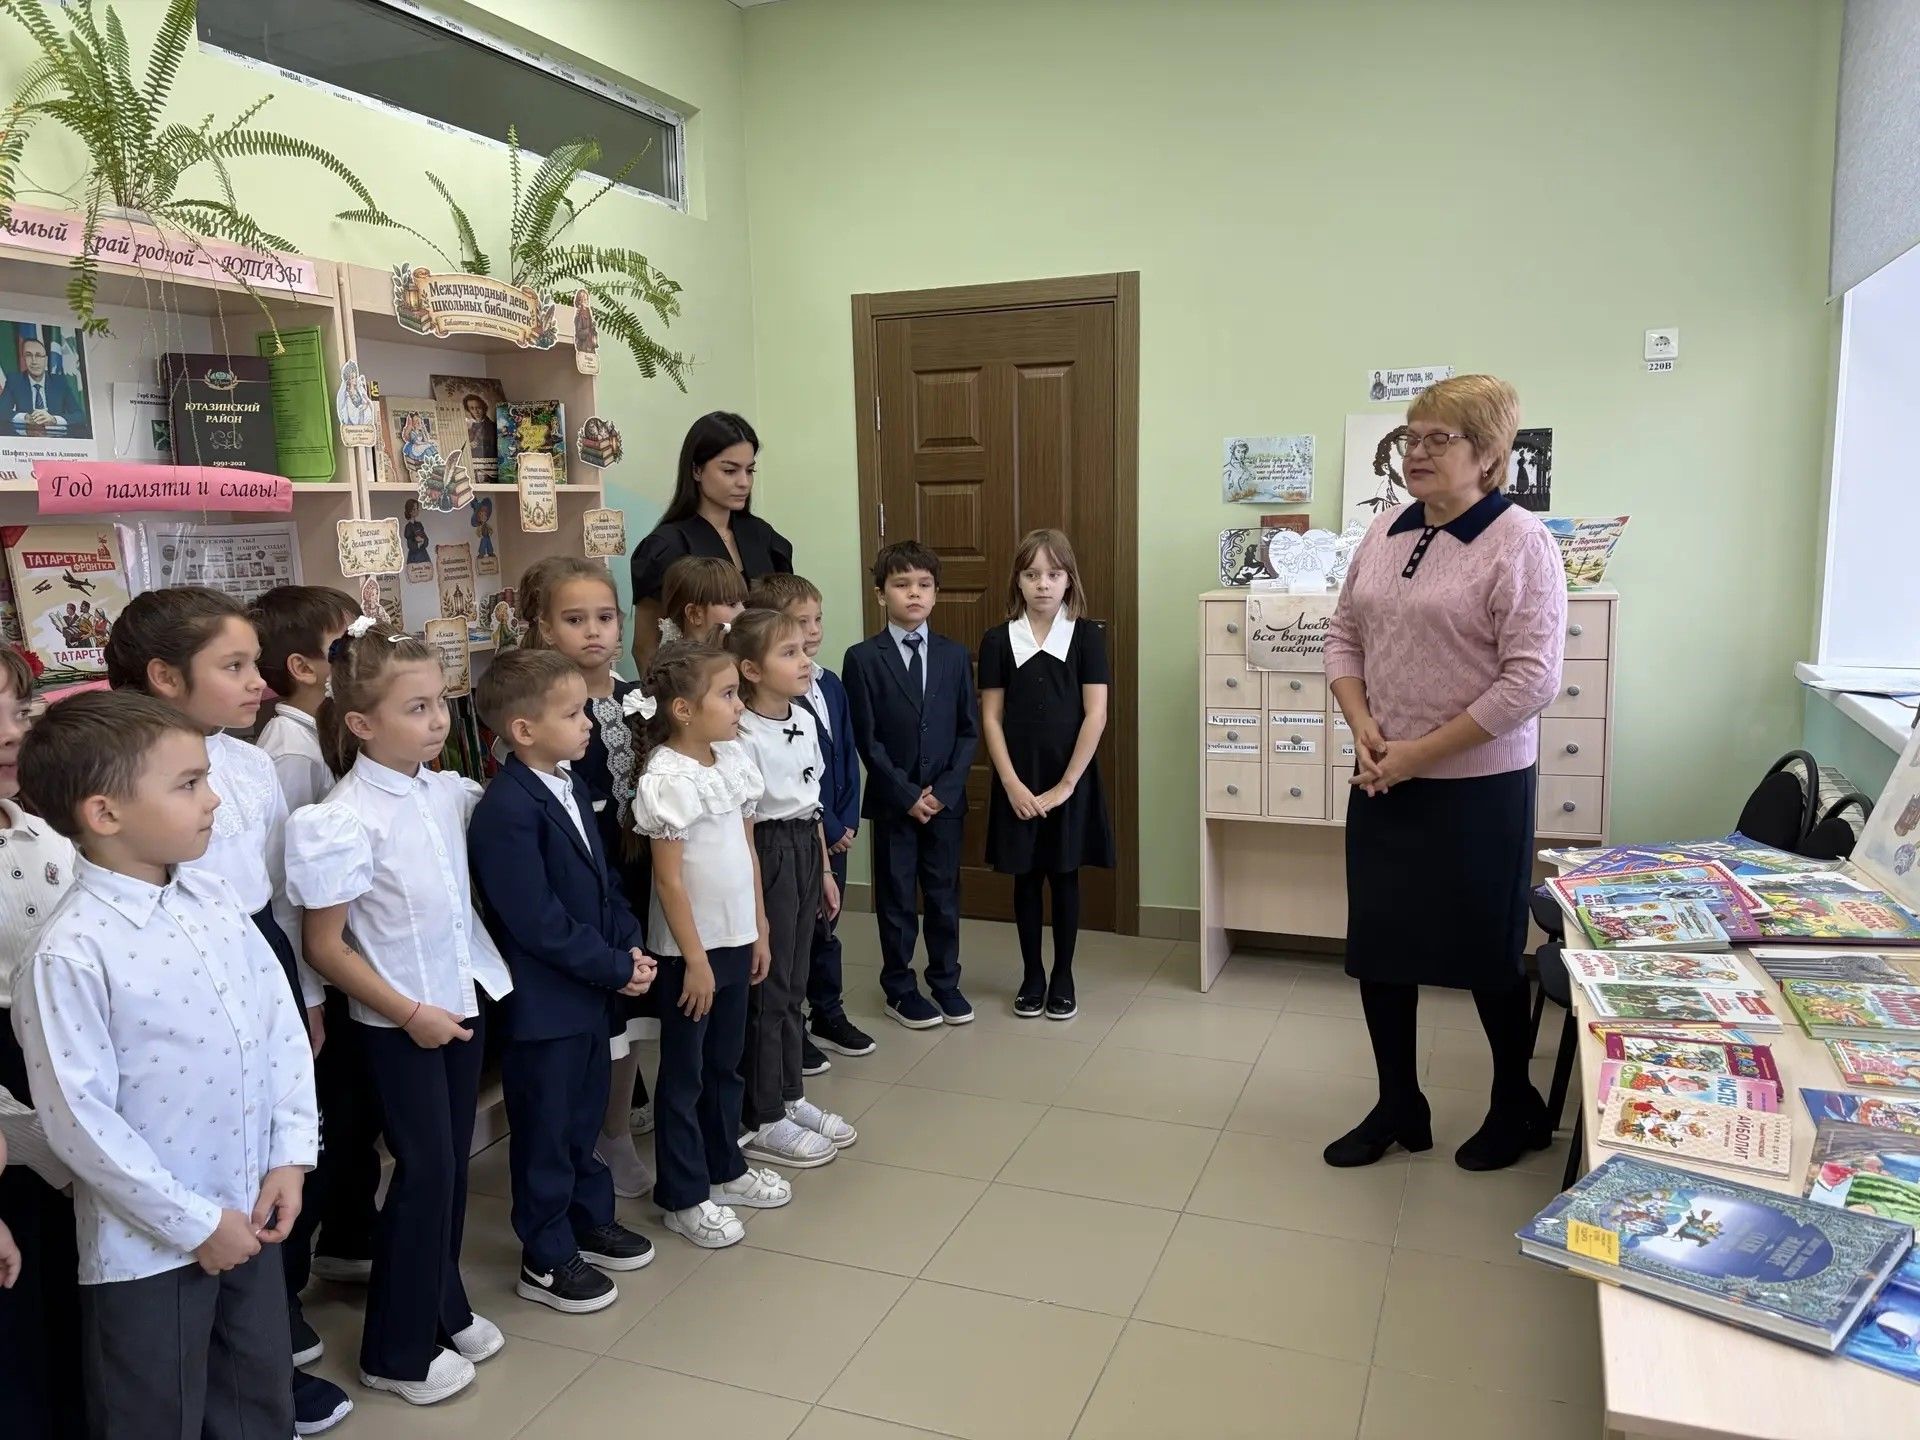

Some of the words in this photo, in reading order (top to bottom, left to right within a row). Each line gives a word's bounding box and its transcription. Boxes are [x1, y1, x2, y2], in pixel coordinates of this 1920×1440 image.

[132, 238, 195, 267] родной
[221, 255, 304, 284] ЮТАЗЫ
[428, 282, 508, 303] Международный
[509, 297, 530, 311] день
[431, 299, 482, 314] школьных
[484, 303, 532, 327] библиотек
[1406, 373, 1423, 383] года,
[1425, 372, 1433, 381] но
[185, 402, 261, 413] ЮТАЗИНСКИЙ
[205, 413, 243, 424] РАЙОН
[52, 472, 92, 497] Год
[106, 480, 190, 498] памяти
[198, 480, 209, 495] и
[220, 479, 278, 497] славы!
[1252, 629, 1276, 641] все
[1211, 715, 1257, 725] Картотека
[1271, 715, 1324, 725] Алфавитный
[1276, 744, 1311, 752] каталог
[1734, 1115, 1755, 1160] АЙБОЛИТ
